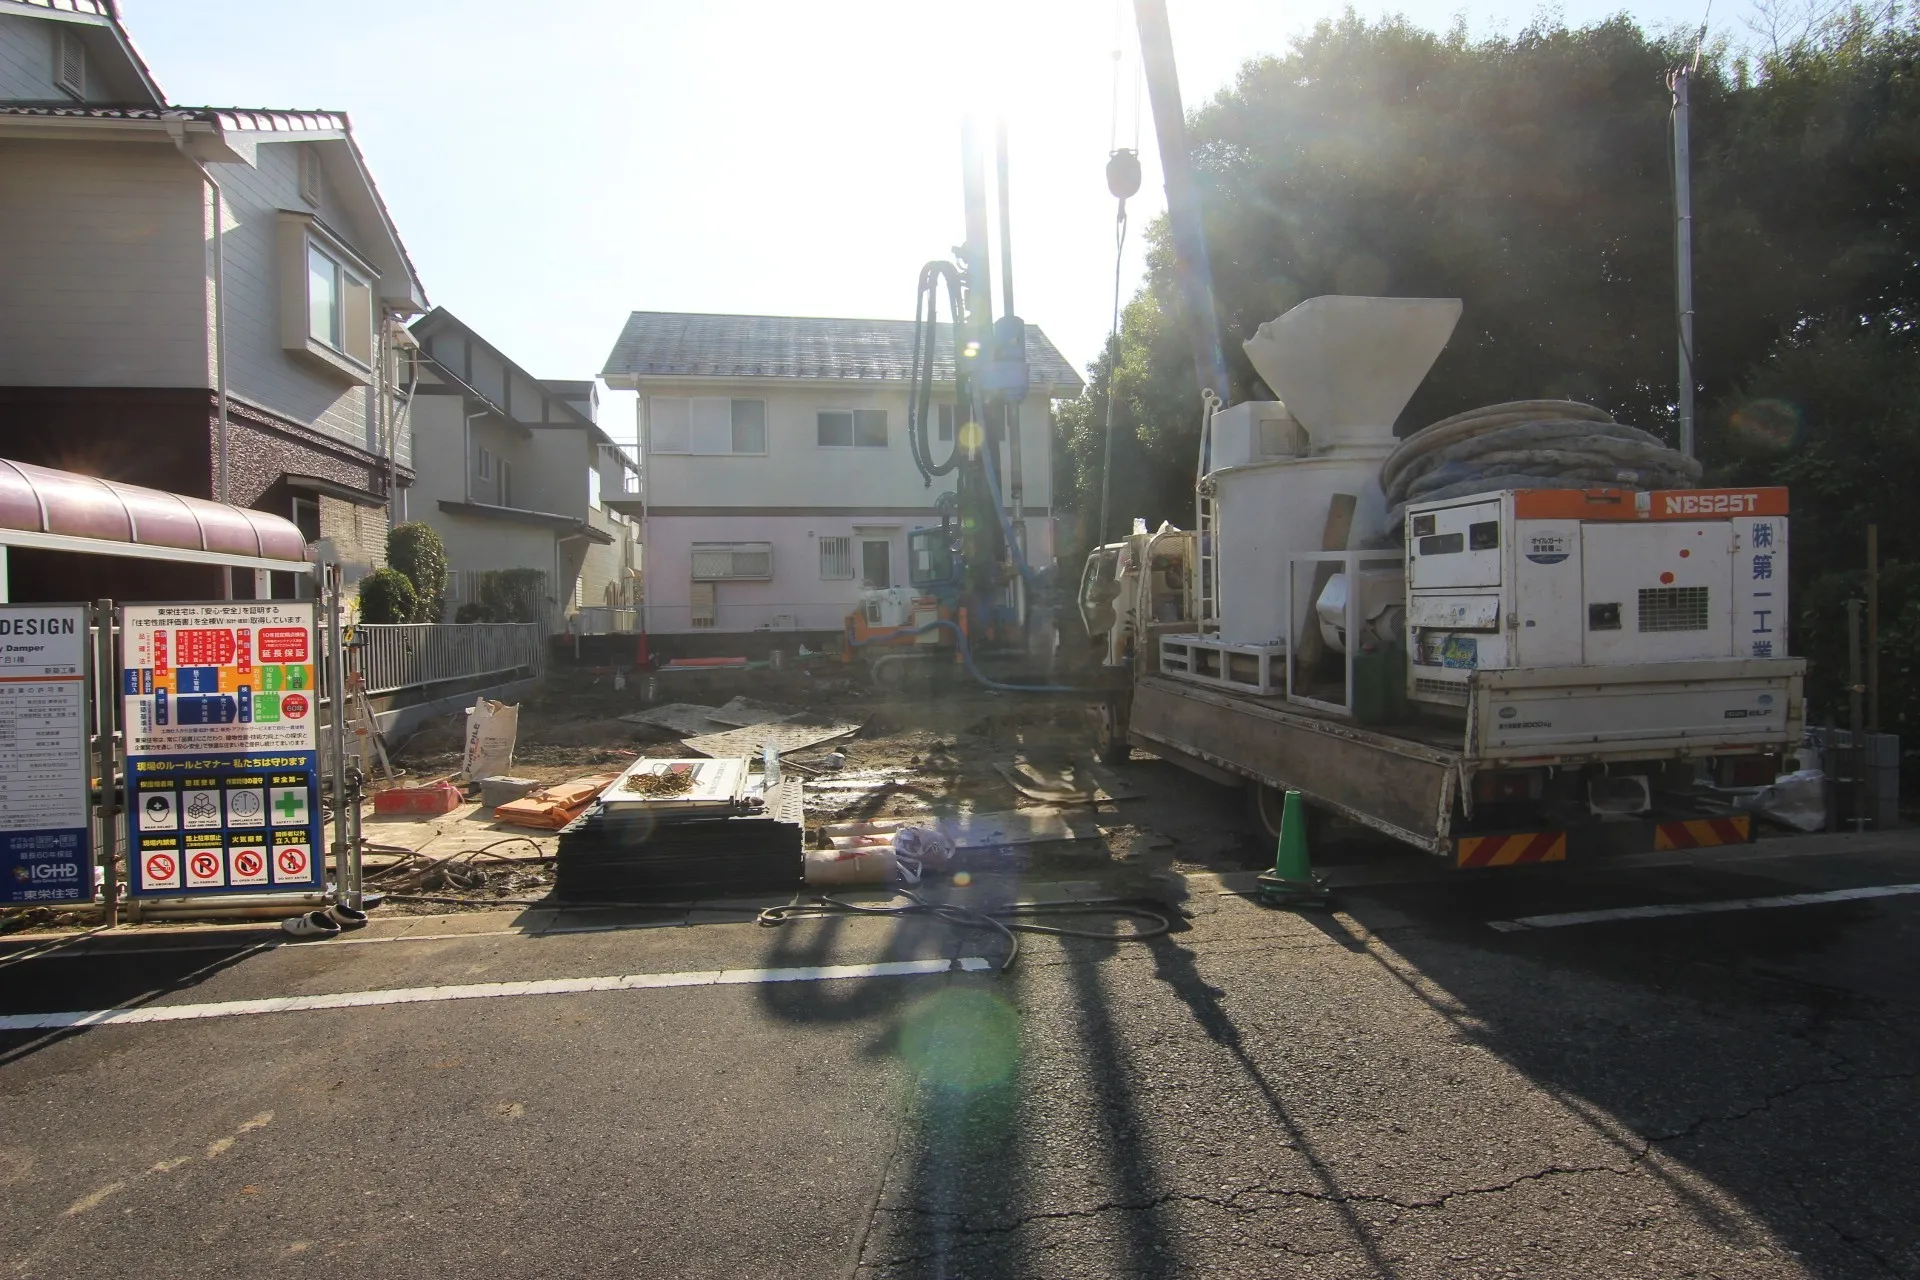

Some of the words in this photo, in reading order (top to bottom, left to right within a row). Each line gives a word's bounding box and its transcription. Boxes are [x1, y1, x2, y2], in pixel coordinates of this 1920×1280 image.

[1665, 494, 1758, 514] NES25T
[0, 618, 74, 635] DESIGN
[6, 644, 45, 652] Damper
[261, 649, 305, 658] 延長保証
[136, 761, 231, 772] 現場のルールとマナー
[233, 756, 307, 769] 私たちは守ります
[272, 776, 304, 784] 安全第一
[232, 835, 263, 843] 火気厳禁
[275, 836, 306, 844] 立入禁止
[24, 888, 79, 900] 東栄住宅
